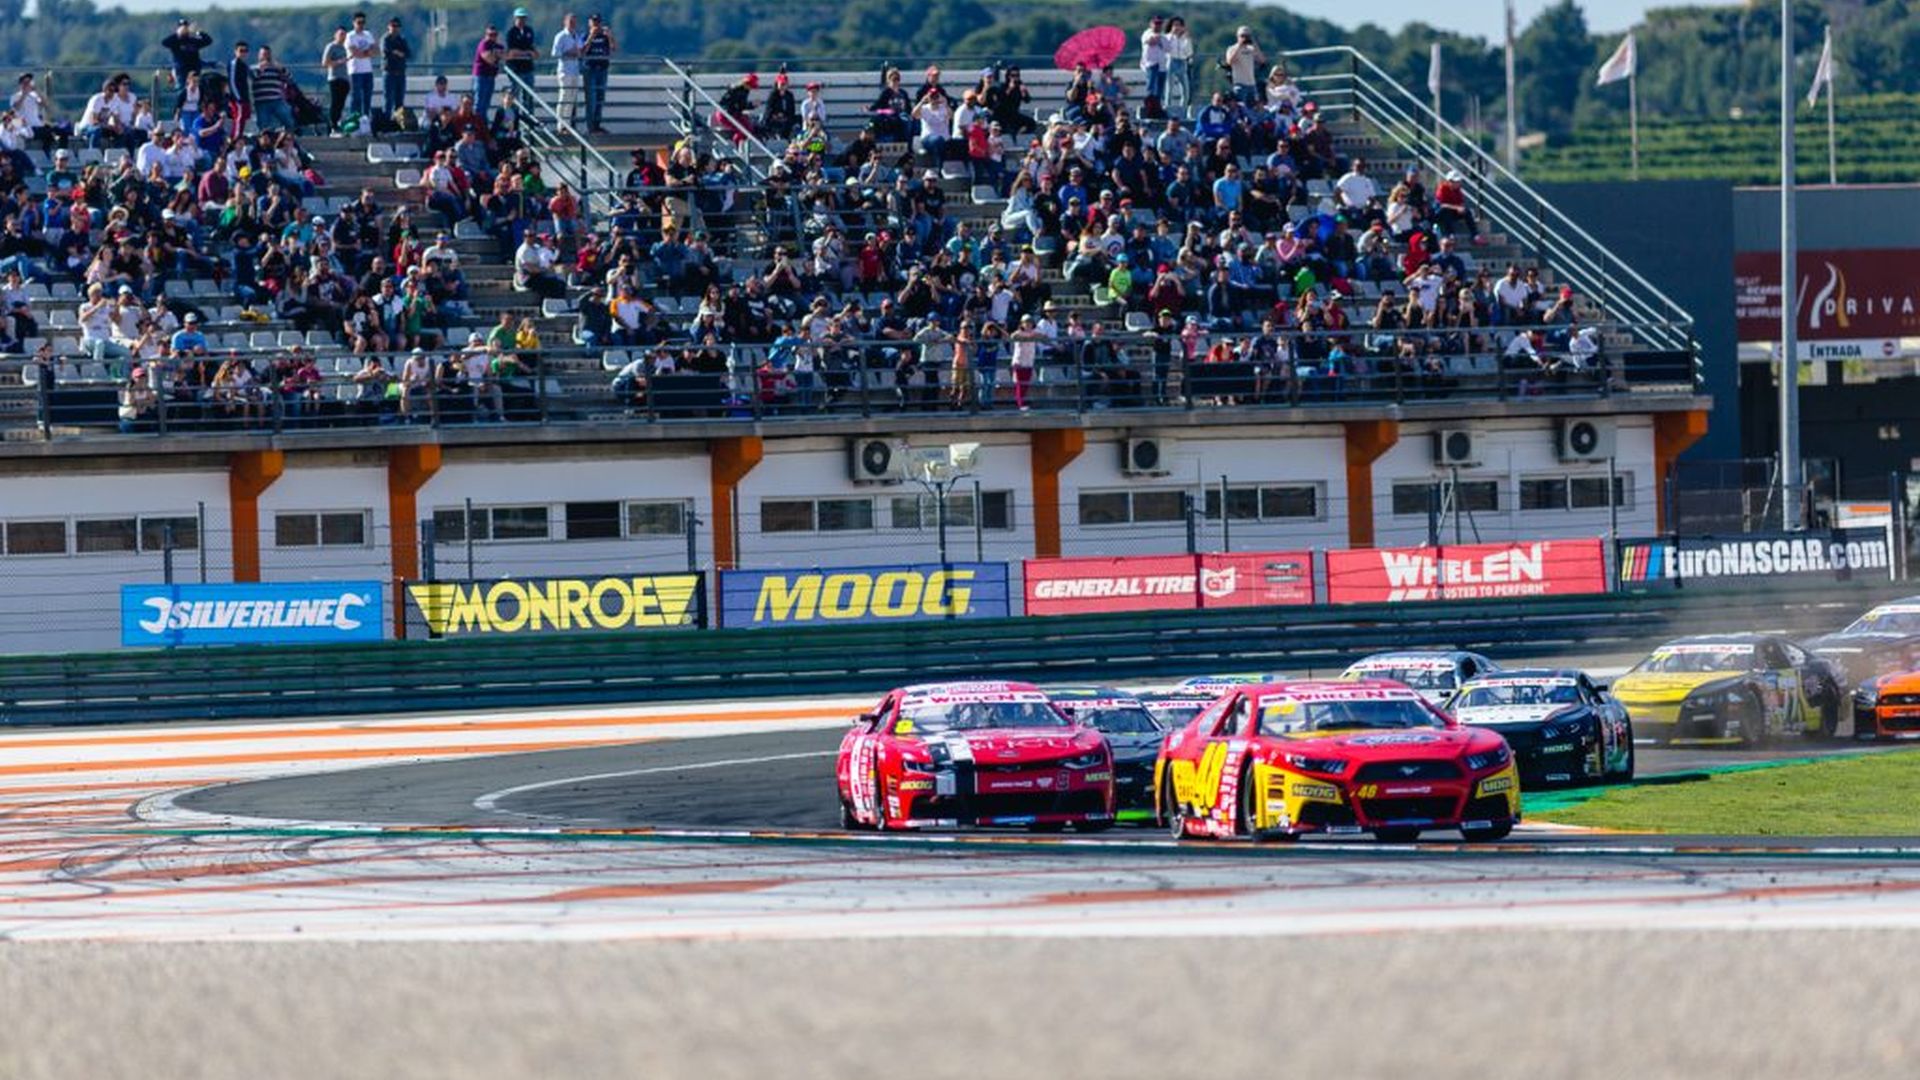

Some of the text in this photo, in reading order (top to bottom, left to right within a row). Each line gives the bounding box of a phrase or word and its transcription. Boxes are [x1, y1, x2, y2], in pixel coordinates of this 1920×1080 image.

[1810, 345, 1861, 358] ENTRADA
[1380, 542, 1543, 586] WHELEN
[1664, 539, 1887, 578] EuroNASCAR.com
[754, 569, 975, 621] MOOG
[1034, 574, 1197, 599] GENERAL TIRE
[1479, 584, 1493, 597] TO
[1494, 583, 1544, 597] PERFORM
[448, 575, 660, 632] MONROE
[1293, 785, 1334, 798] MOOG
